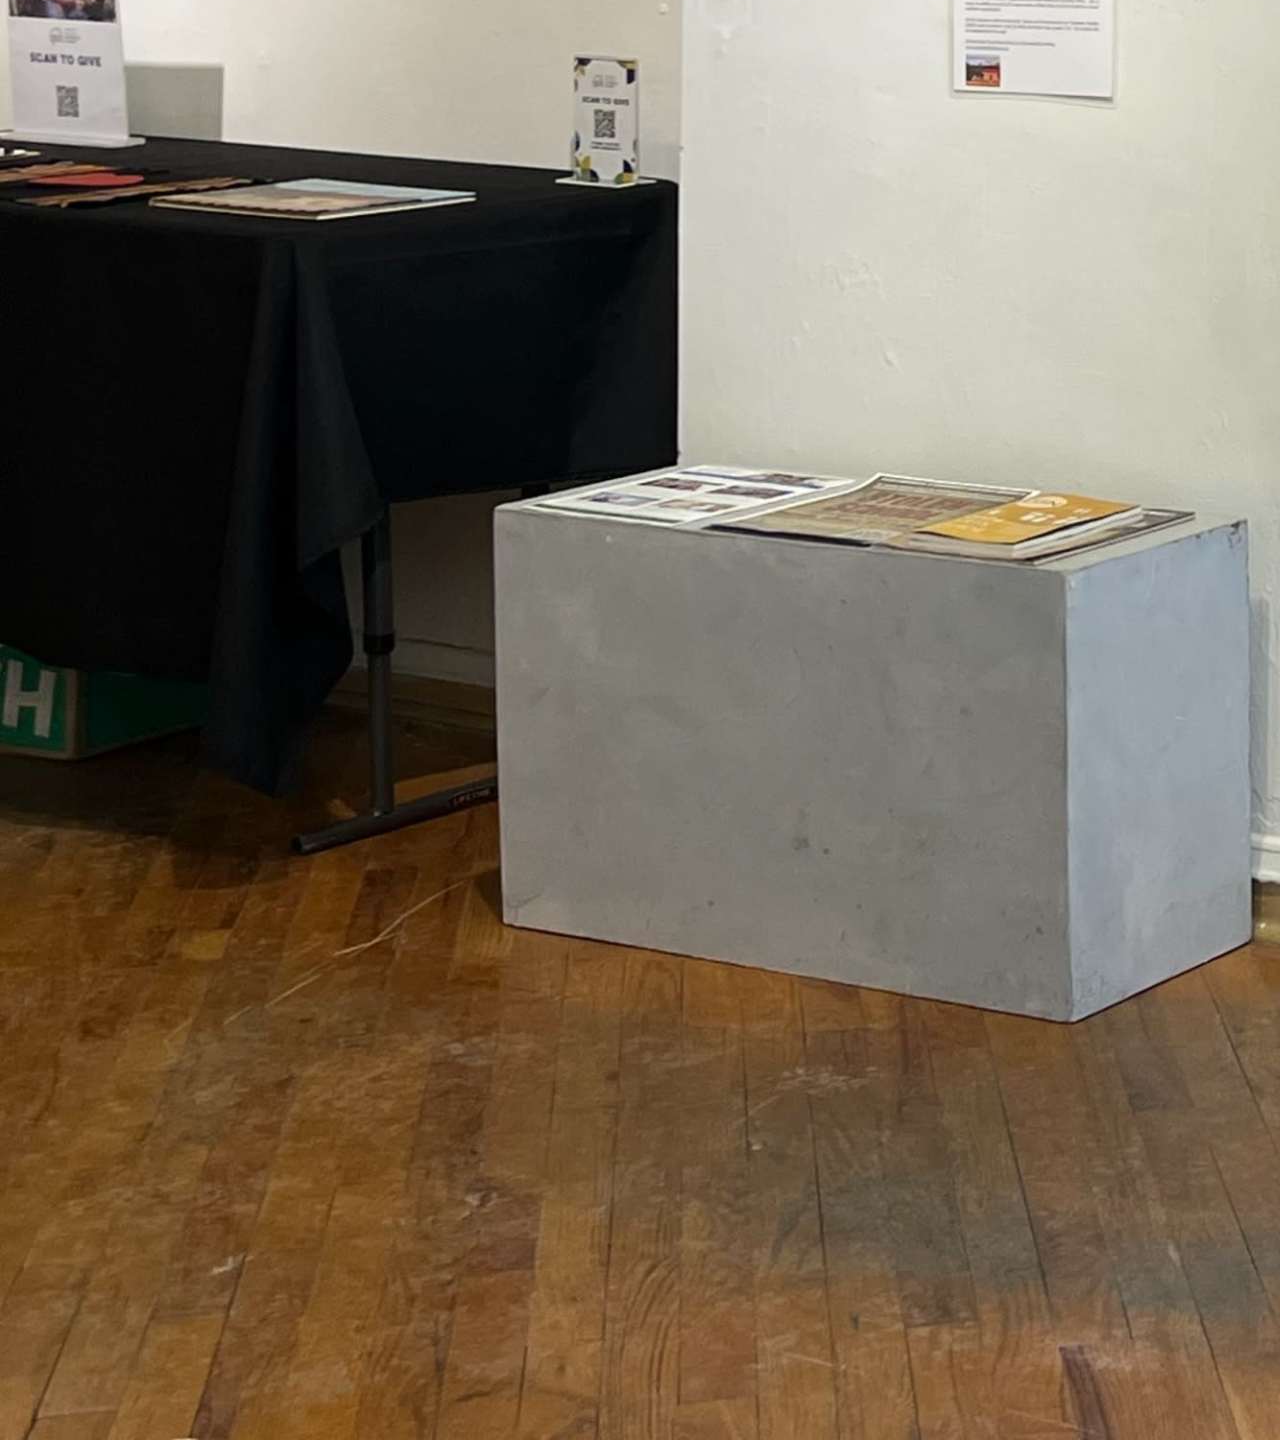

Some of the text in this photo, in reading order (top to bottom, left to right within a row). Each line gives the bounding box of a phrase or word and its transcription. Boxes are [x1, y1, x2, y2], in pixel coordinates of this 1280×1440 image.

[29, 51, 102, 68] SCAN TO GIVE
